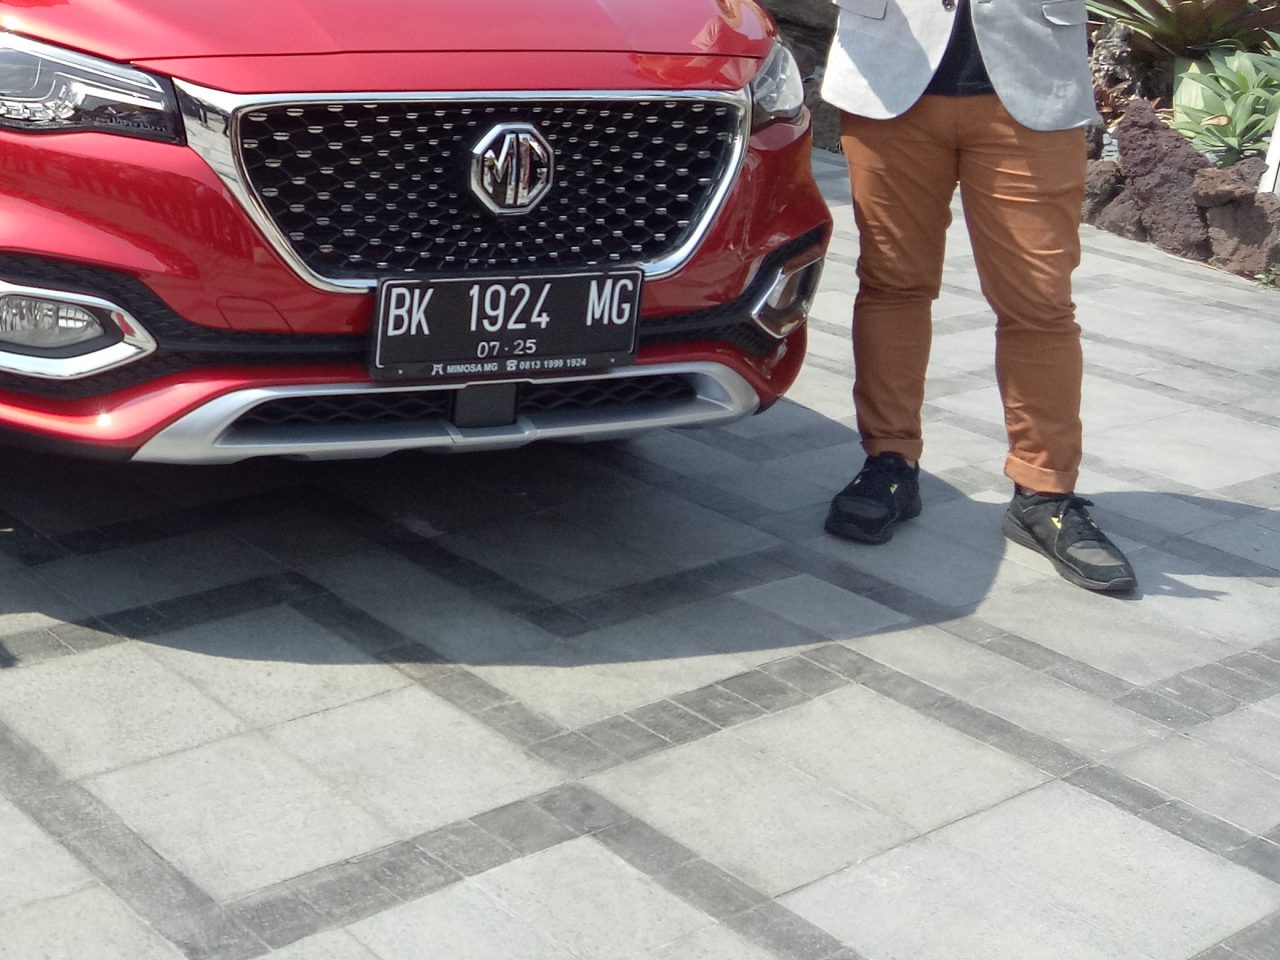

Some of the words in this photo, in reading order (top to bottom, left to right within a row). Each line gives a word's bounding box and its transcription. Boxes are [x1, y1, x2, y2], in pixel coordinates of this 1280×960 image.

[483, 133, 547, 206] MG
[387, 287, 434, 336] BK
[469, 283, 552, 332] 1924
[586, 279, 634, 326] MG
[446, 363, 482, 374] MIMOSA
[483, 362, 498, 372] MG
[519, 360, 541, 370] 0813
[566, 358, 587, 368] 1924
